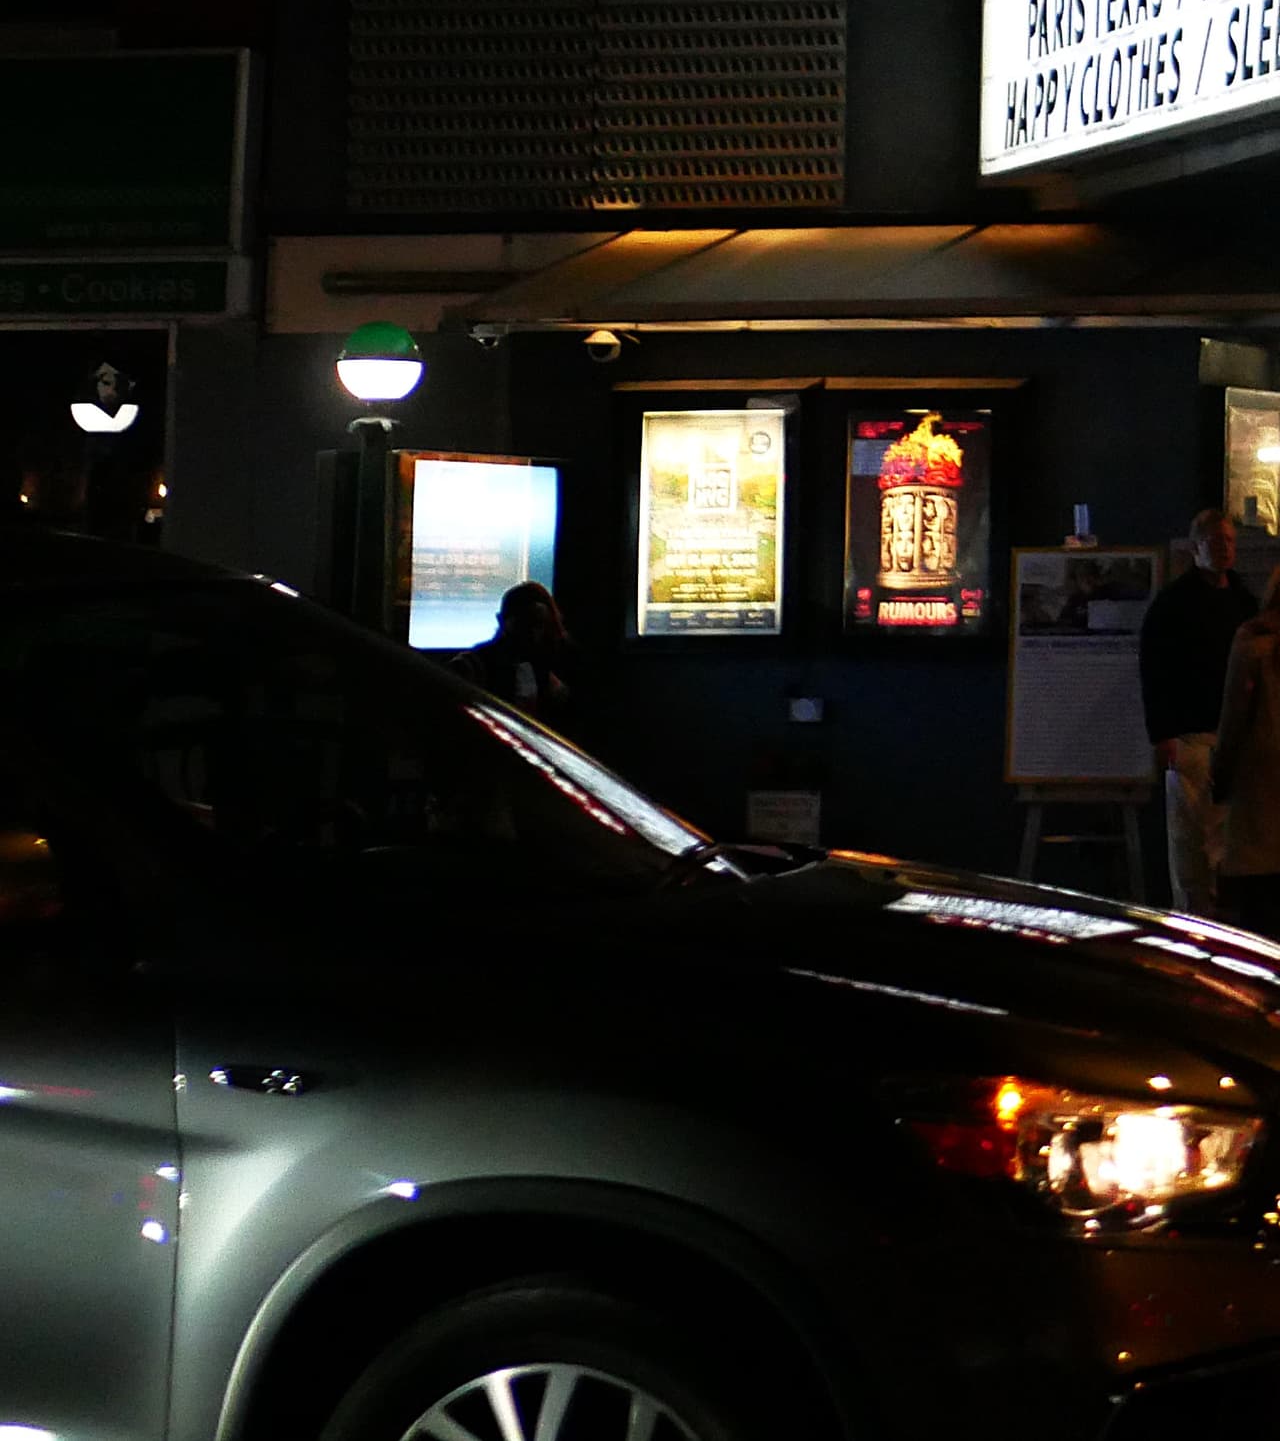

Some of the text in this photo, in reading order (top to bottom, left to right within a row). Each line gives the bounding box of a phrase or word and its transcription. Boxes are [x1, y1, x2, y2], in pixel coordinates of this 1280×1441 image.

[1003, 60, 1076, 151] HAPPY
[1080, 27, 1185, 127] CLOTHES
[1195, 18, 1213, 96] /
[60, 271, 196, 304] Cookies
[876, 600, 960, 627] RUMOURS
